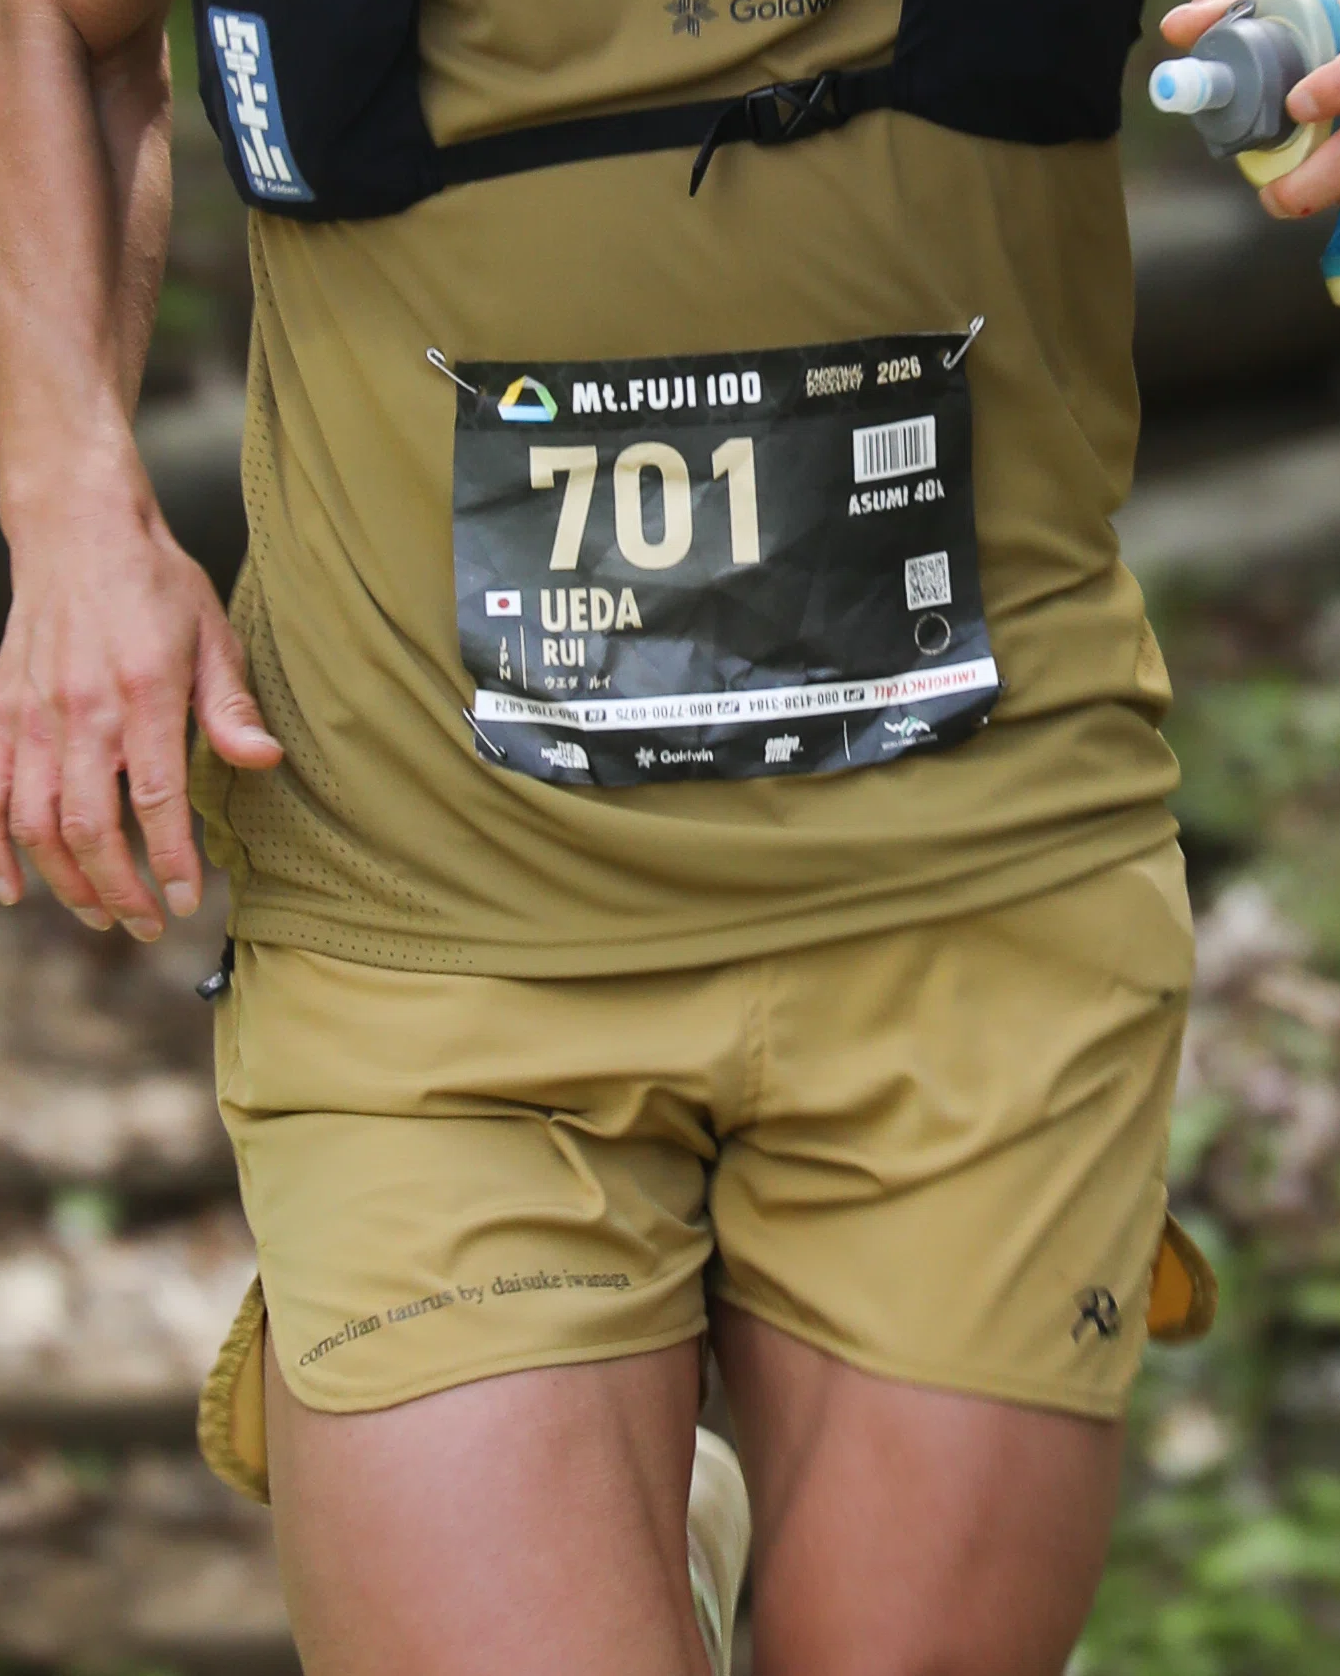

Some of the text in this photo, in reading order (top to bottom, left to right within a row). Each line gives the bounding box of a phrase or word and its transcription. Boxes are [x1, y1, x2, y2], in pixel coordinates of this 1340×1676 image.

[876, 355, 922, 385] 2026
[572, 375, 697, 414] Mt.FUJI
[529, 437, 761, 571] 701
[847, 485, 909, 517] ASUMI
[540, 587, 643, 633] UEDA
[498, 636, 512, 681] JPN
[542, 637, 586, 667] RUI
[902, 668, 977, 697] EMERGENCY
[660, 747, 714, 765] Goldwin
[386, 1289, 455, 1324] taurus
[456, 1284, 485, 1305] by
